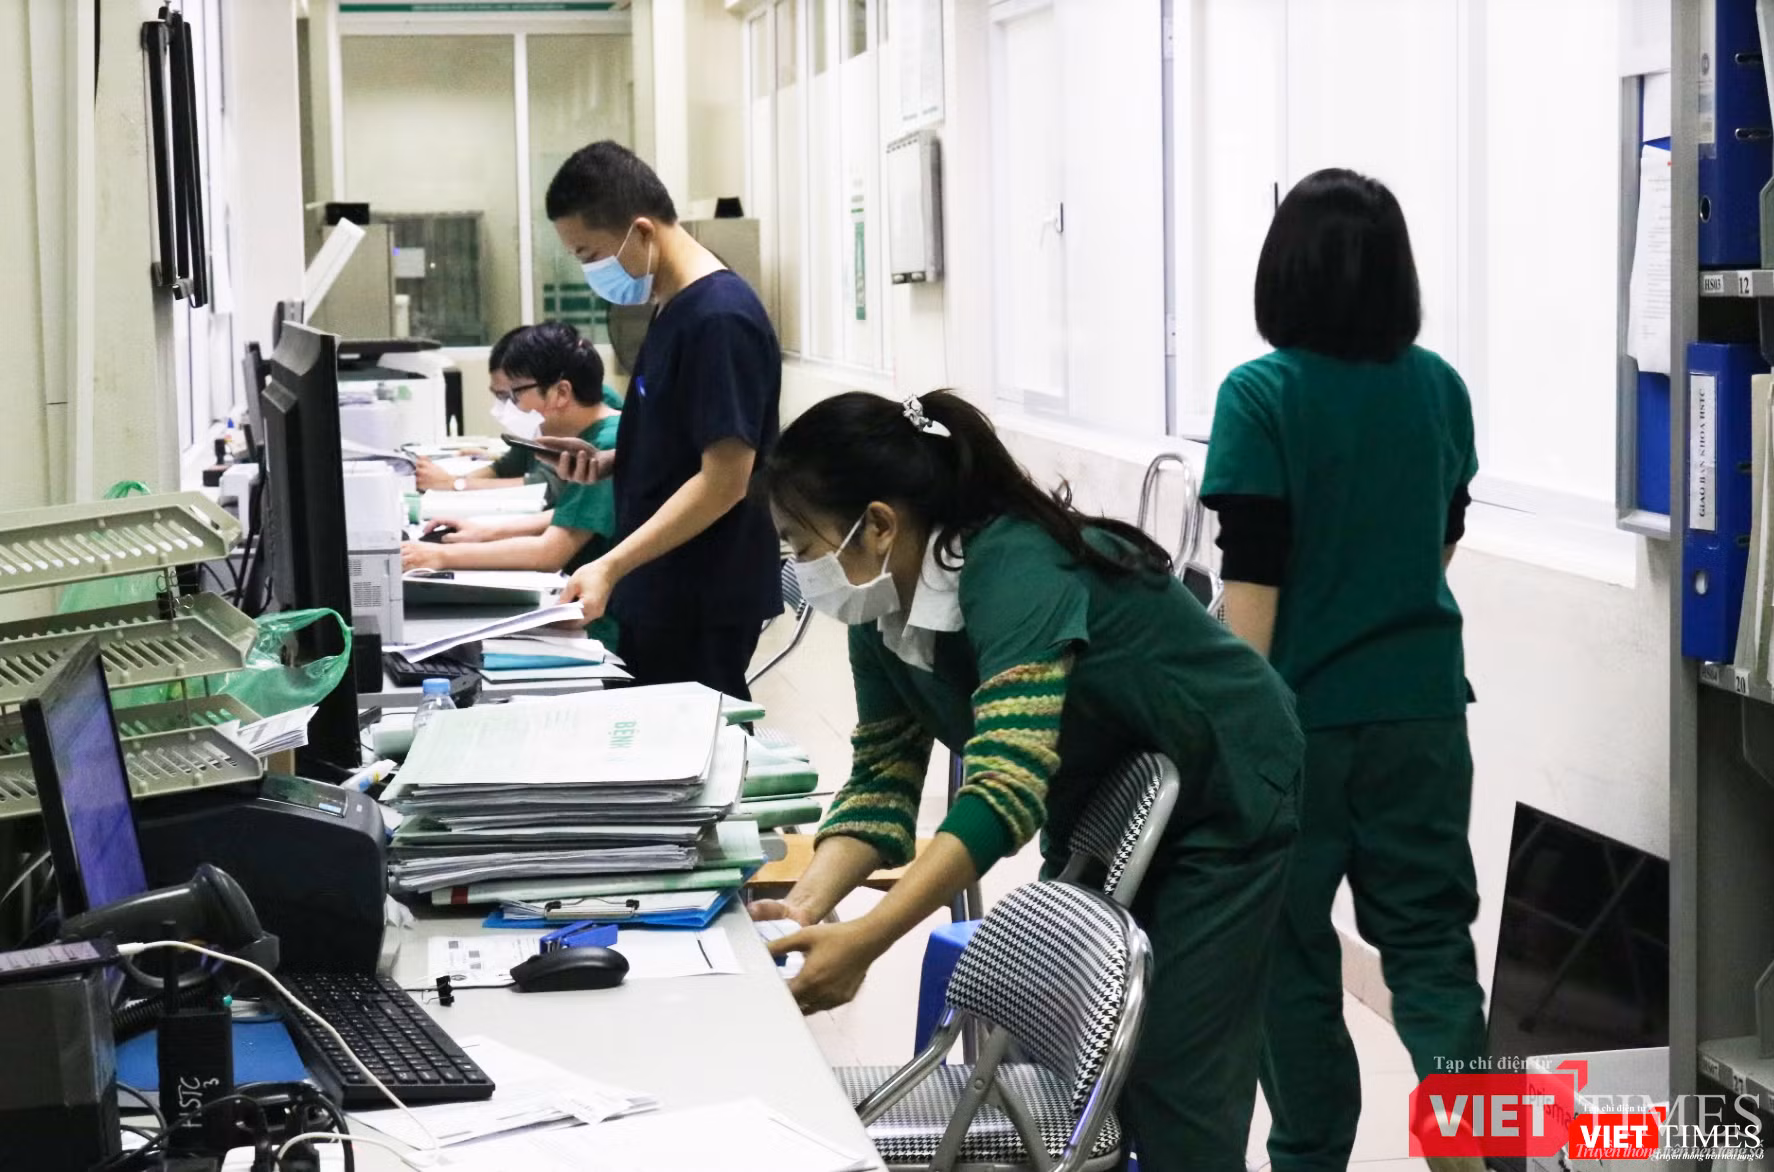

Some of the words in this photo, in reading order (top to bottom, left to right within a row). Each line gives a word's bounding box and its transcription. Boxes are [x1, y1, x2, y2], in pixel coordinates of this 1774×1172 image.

[1739, 276, 1750, 295] 12
[1736, 676, 1746, 694] 20
[203, 1077, 220, 1089] 3
[179, 1076, 203, 1128] HSTC
